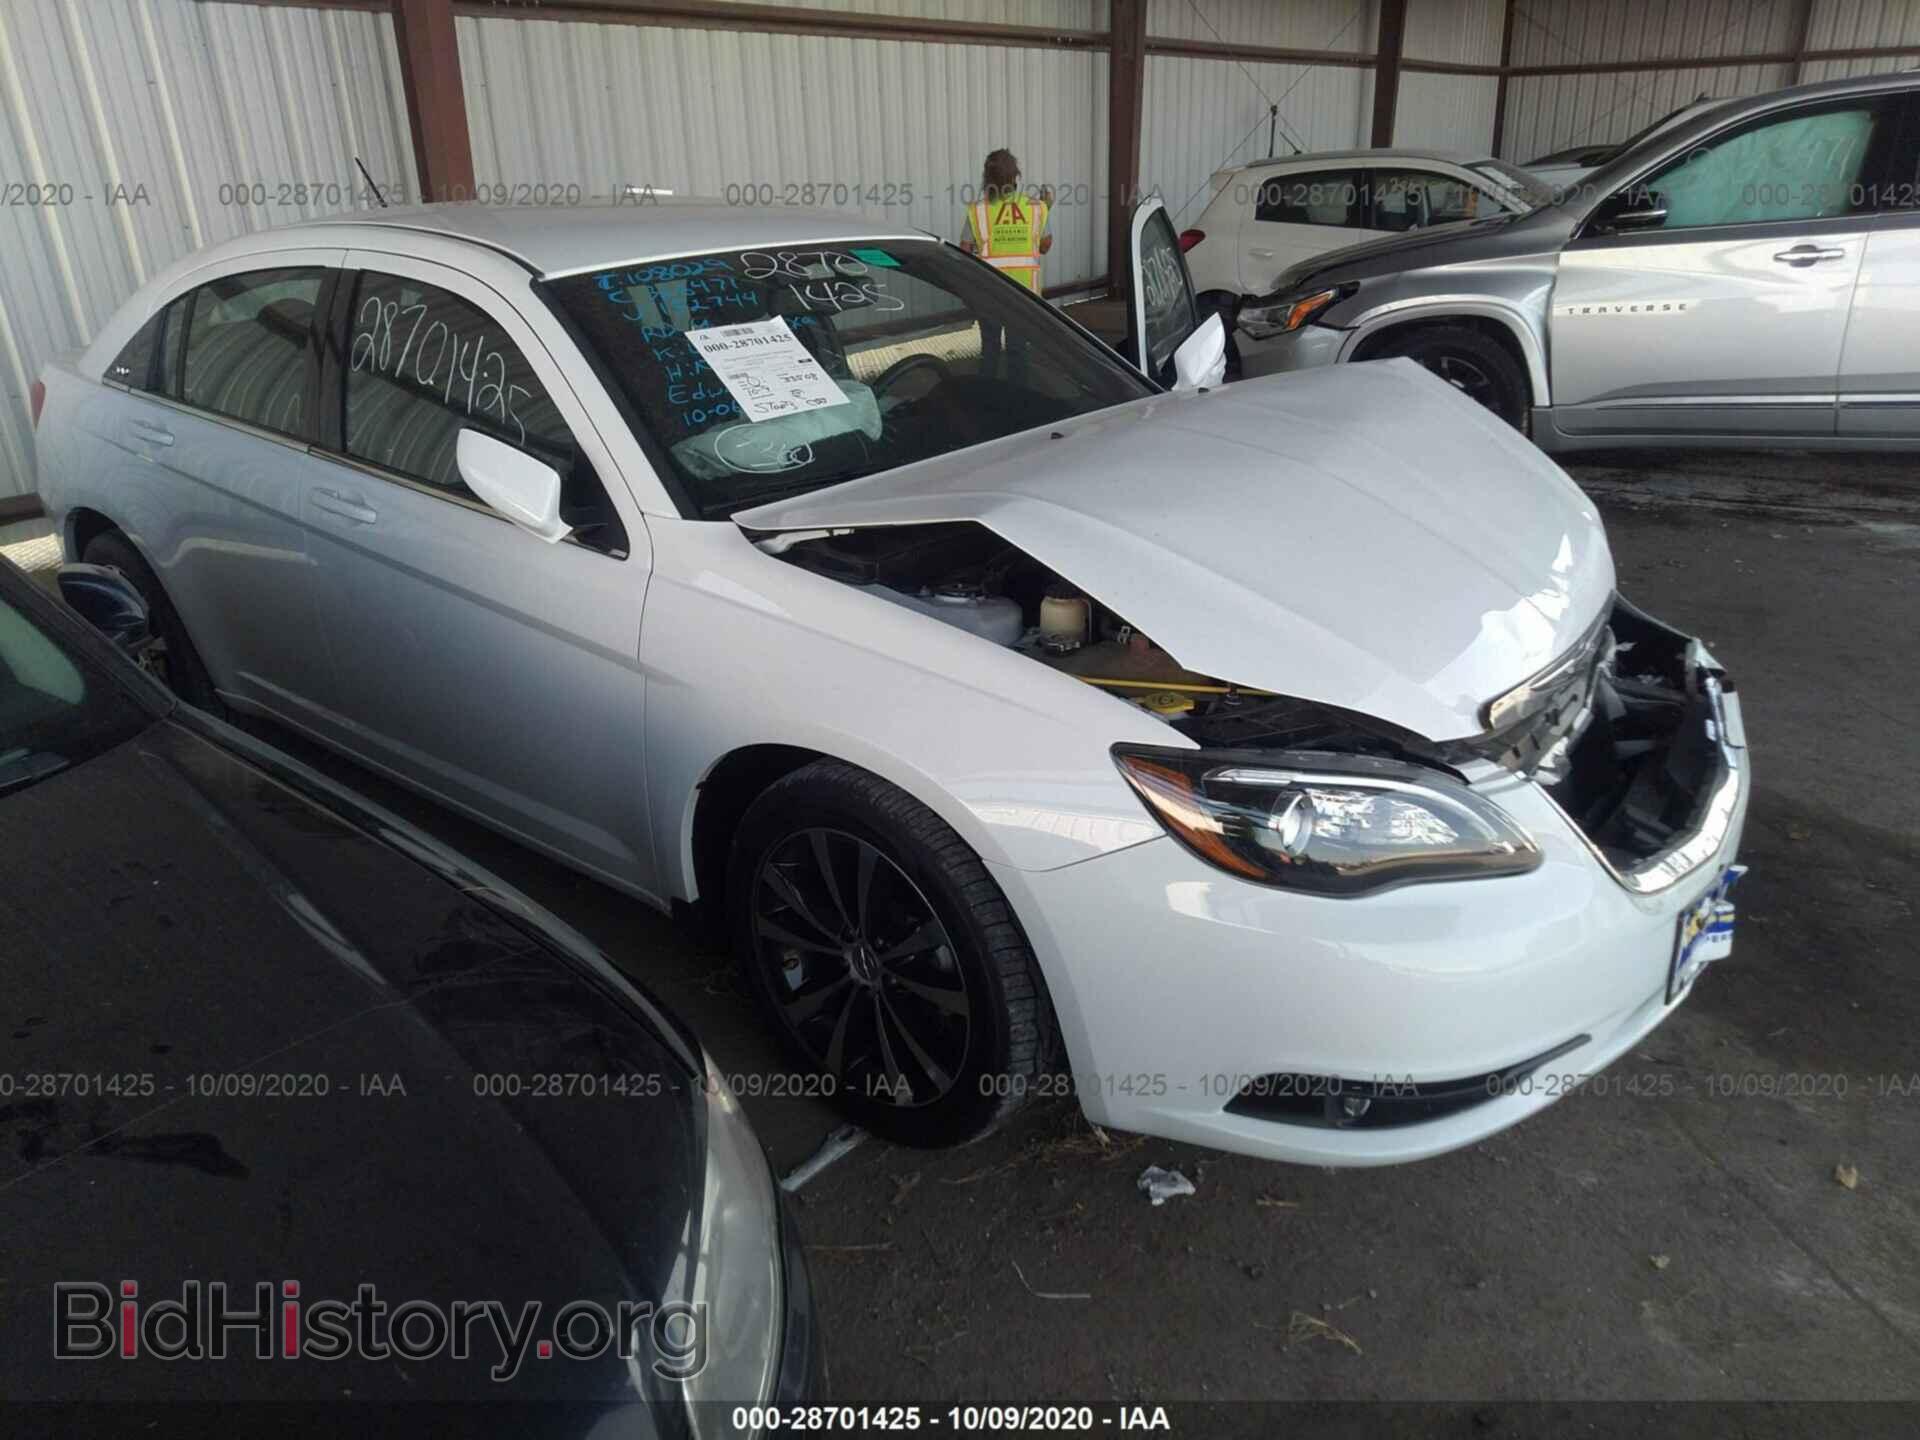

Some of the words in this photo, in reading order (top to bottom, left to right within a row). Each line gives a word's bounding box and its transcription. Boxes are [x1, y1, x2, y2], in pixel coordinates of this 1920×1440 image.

[740, 250, 869, 279] 2870
[788, 281, 905, 311] 1425
[1568, 304, 1686, 314] TRAVERSE
[703, 333, 793, 353] 000-28701425
[352, 297, 533, 446] 28701425
